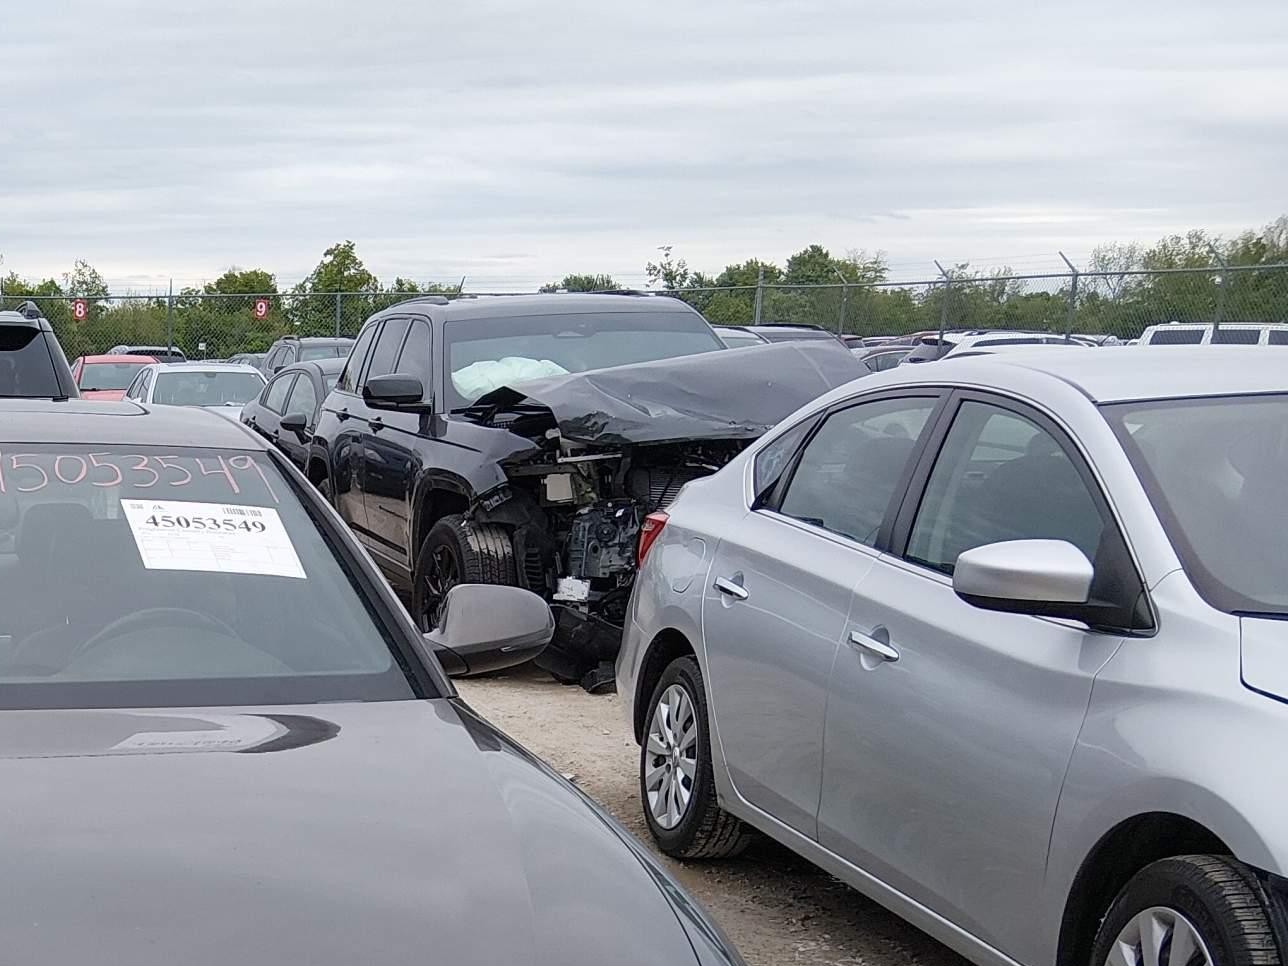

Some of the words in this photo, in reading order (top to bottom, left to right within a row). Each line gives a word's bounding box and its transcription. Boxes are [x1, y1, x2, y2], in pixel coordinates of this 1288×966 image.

[75, 303, 85, 317] 8
[256, 302, 265, 315] 9
[145, 513, 266, 534] 45053549
